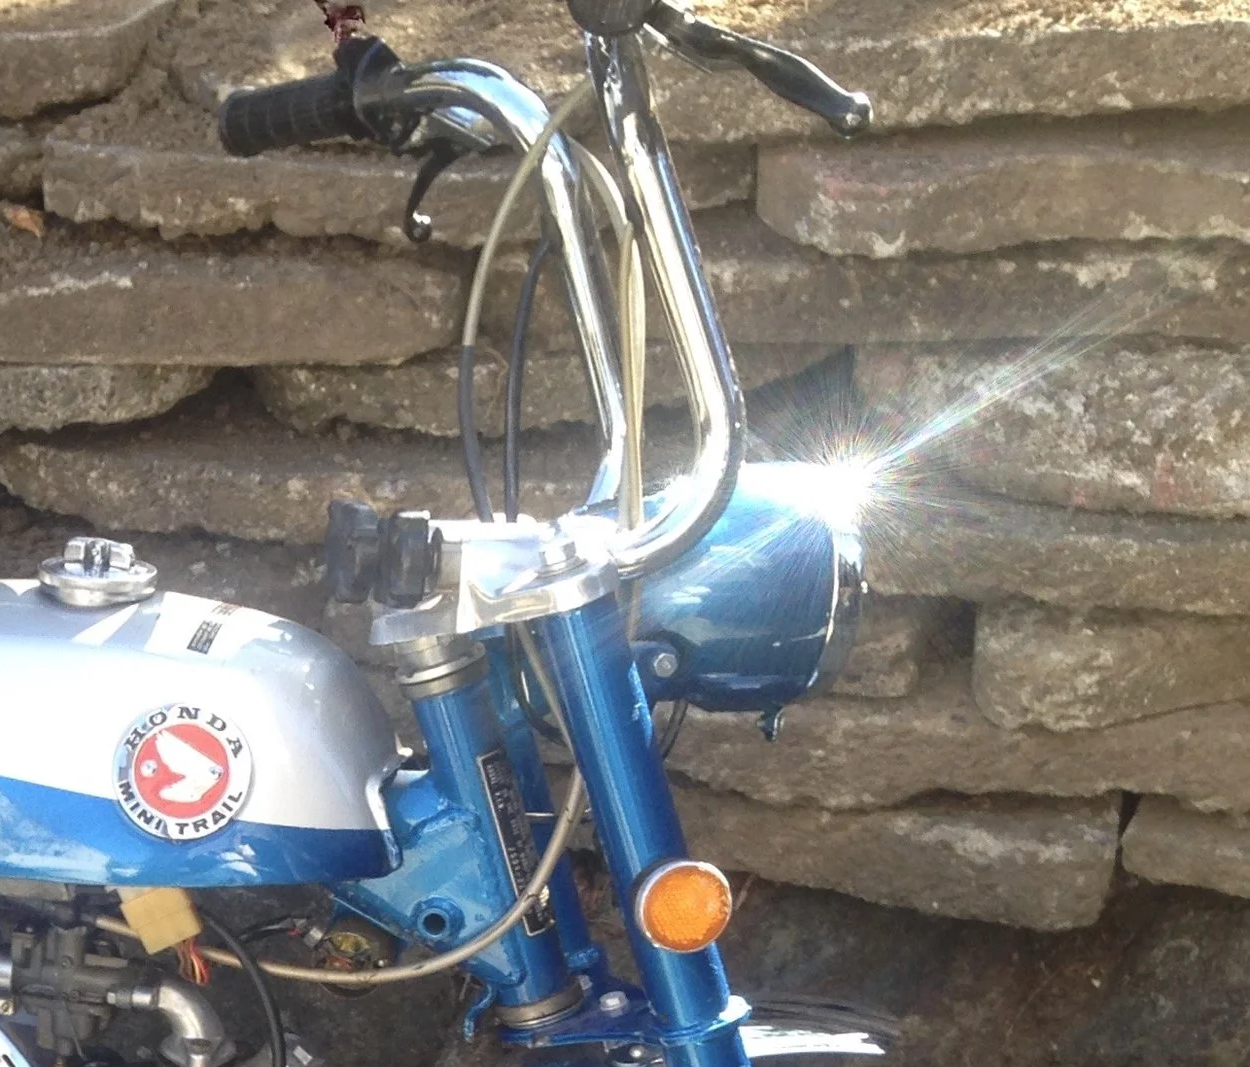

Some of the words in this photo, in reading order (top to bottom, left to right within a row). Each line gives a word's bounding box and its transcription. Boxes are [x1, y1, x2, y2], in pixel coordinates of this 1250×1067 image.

[125, 706, 243, 758] HONDA
[119, 781, 165, 830] MINI
[175, 792, 242, 835] TRAIL
